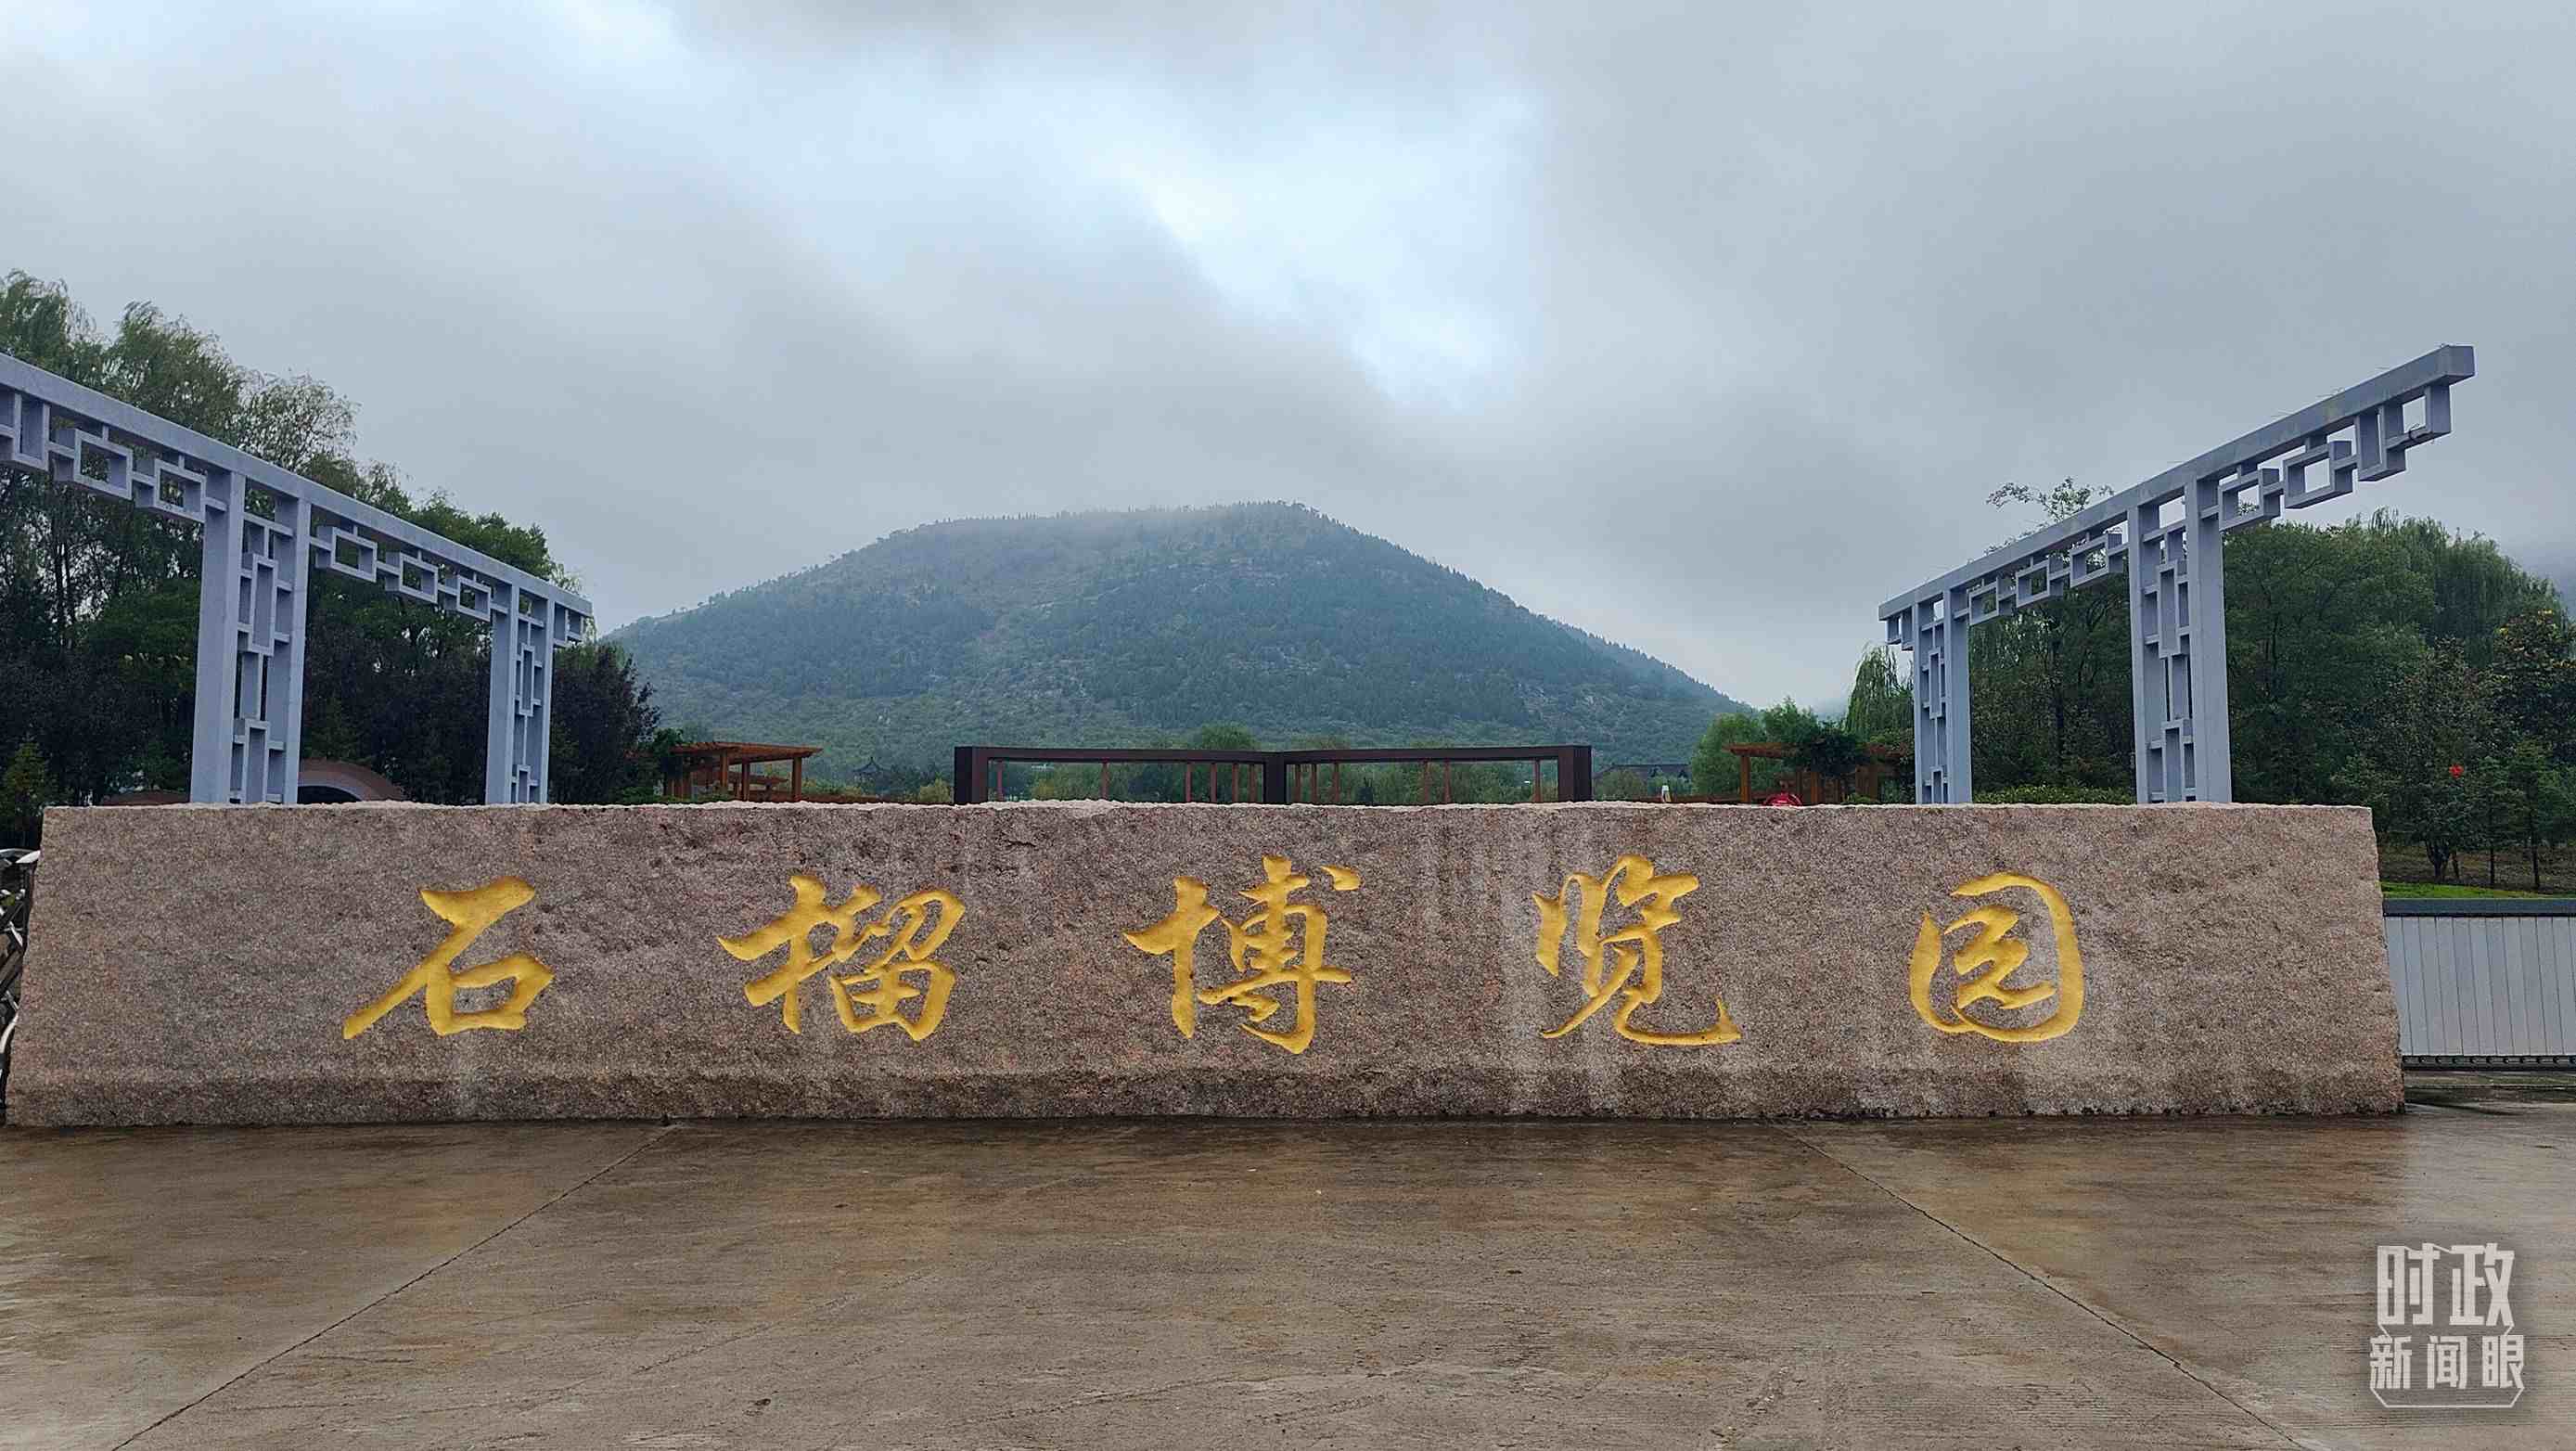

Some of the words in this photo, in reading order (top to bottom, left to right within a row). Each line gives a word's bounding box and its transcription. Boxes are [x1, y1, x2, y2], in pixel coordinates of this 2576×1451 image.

[342, 854, 2085, 1055] 石榴博览园
